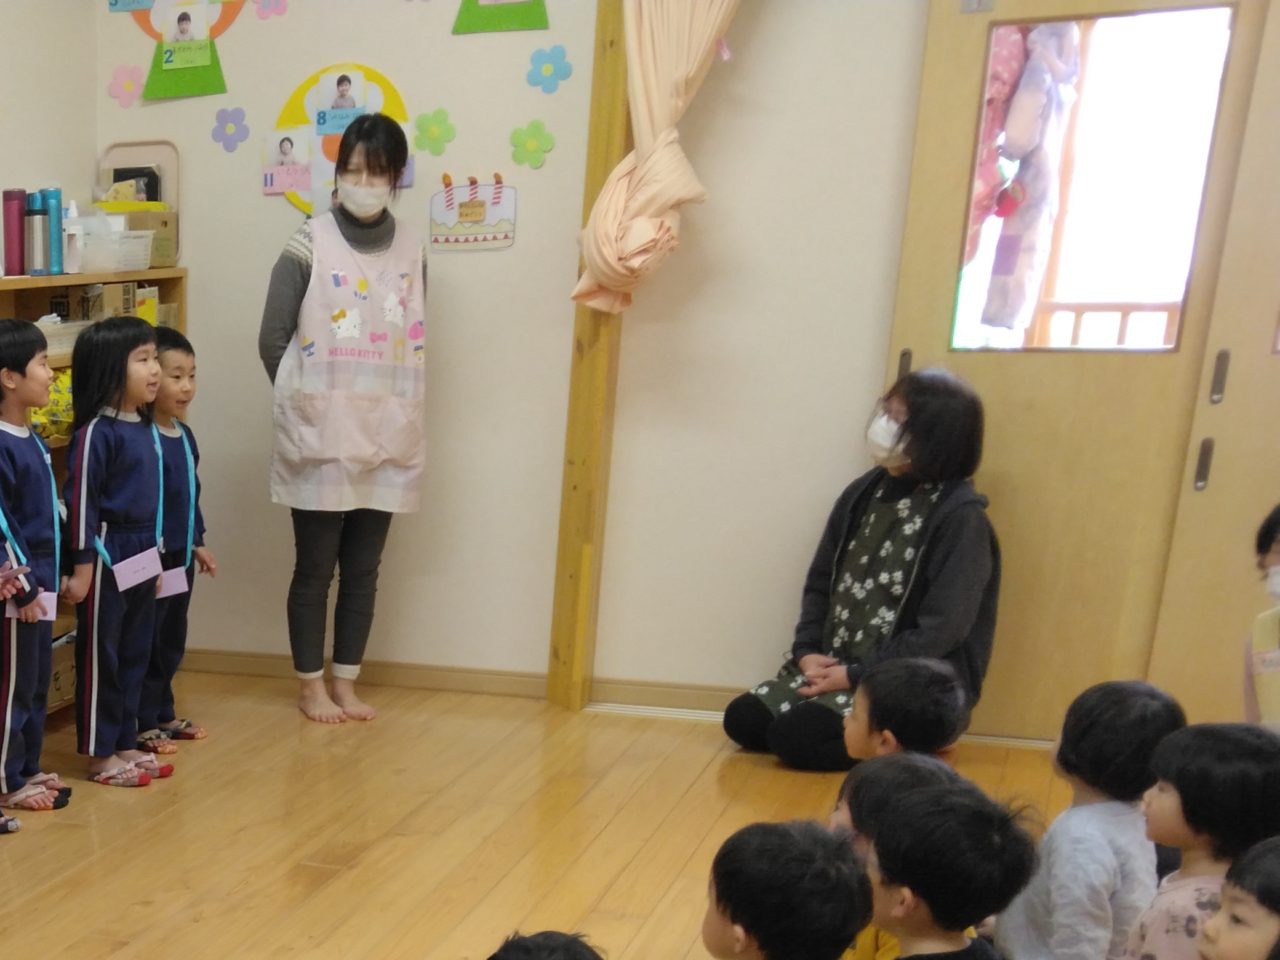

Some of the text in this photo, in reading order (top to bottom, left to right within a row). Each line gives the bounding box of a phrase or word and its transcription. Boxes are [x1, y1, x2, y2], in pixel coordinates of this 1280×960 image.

[163, 49, 174, 64] 2
[317, 110, 327, 126] 8
[263, 172, 274, 187] 11
[328, 347, 385, 361] HELLO KITTY
